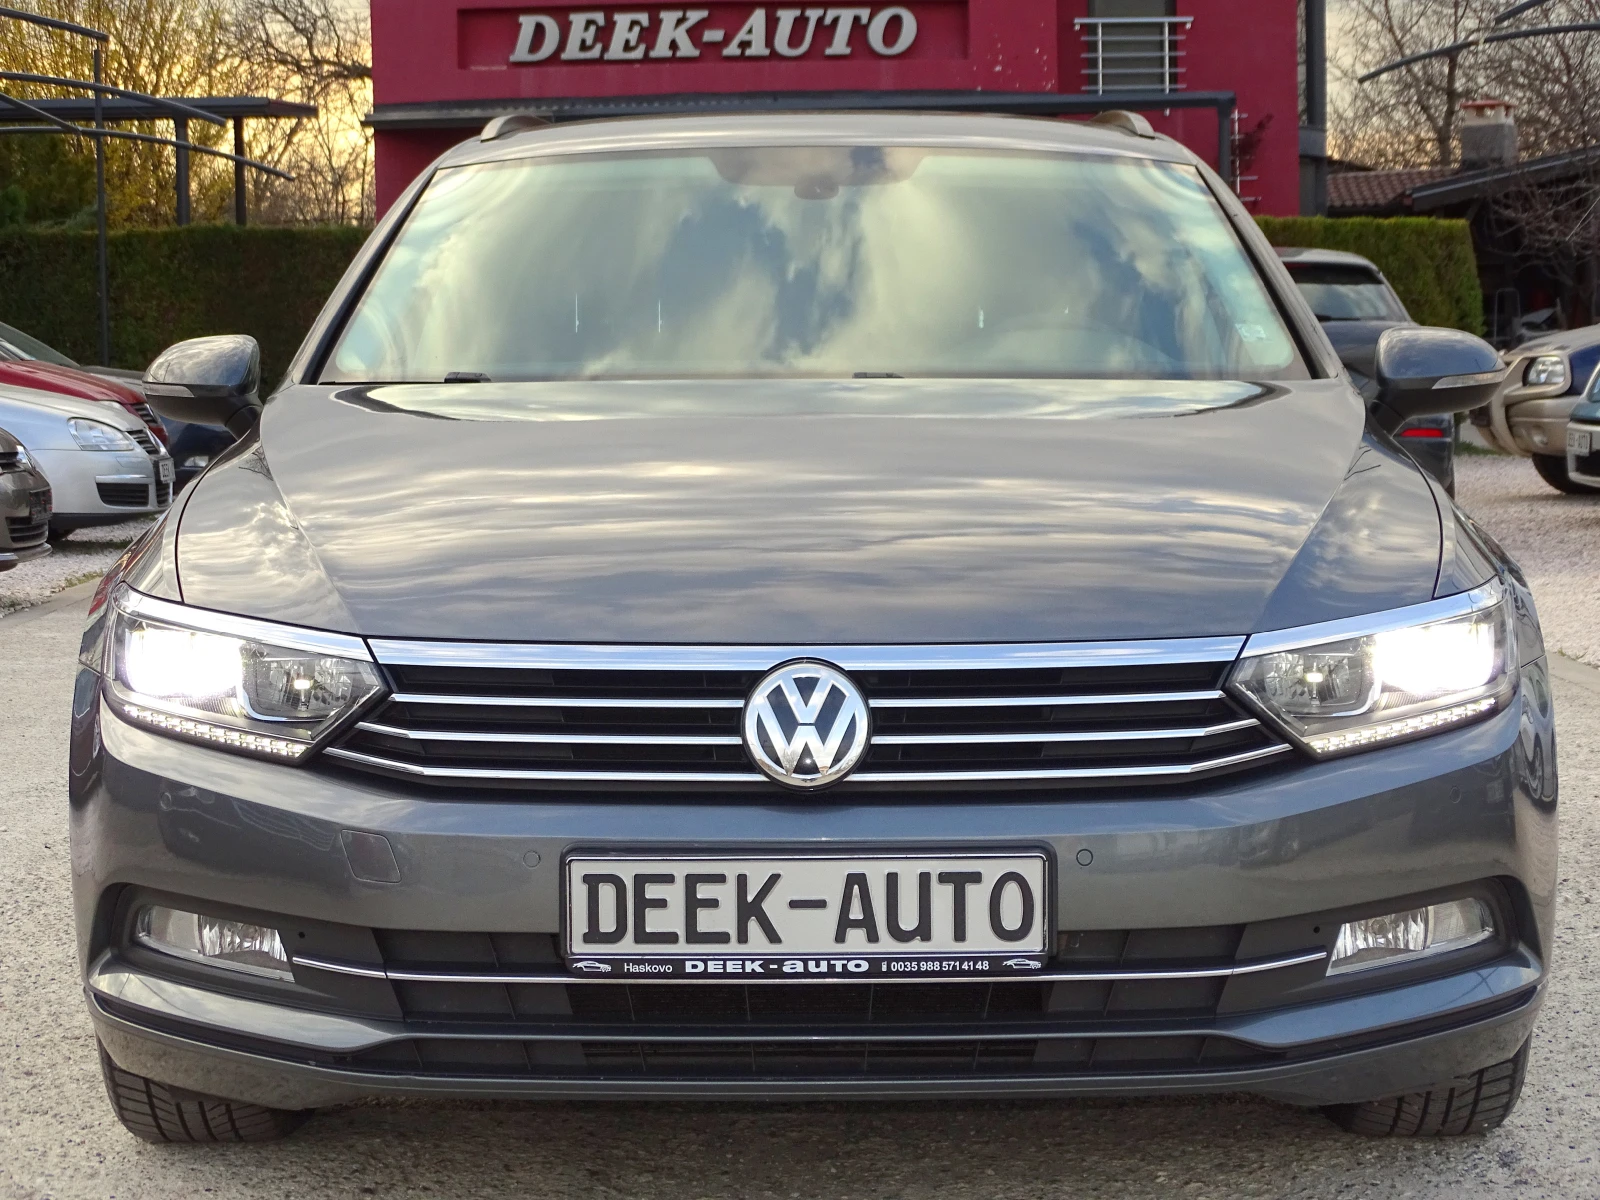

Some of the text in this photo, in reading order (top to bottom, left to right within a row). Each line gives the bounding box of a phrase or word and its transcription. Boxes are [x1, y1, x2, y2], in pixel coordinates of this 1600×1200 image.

[509, 6, 918, 63] DEEK-AUTO
[582, 871, 1035, 944] DEEK-AUTO
[624, 962, 673, 973] Haskovo
